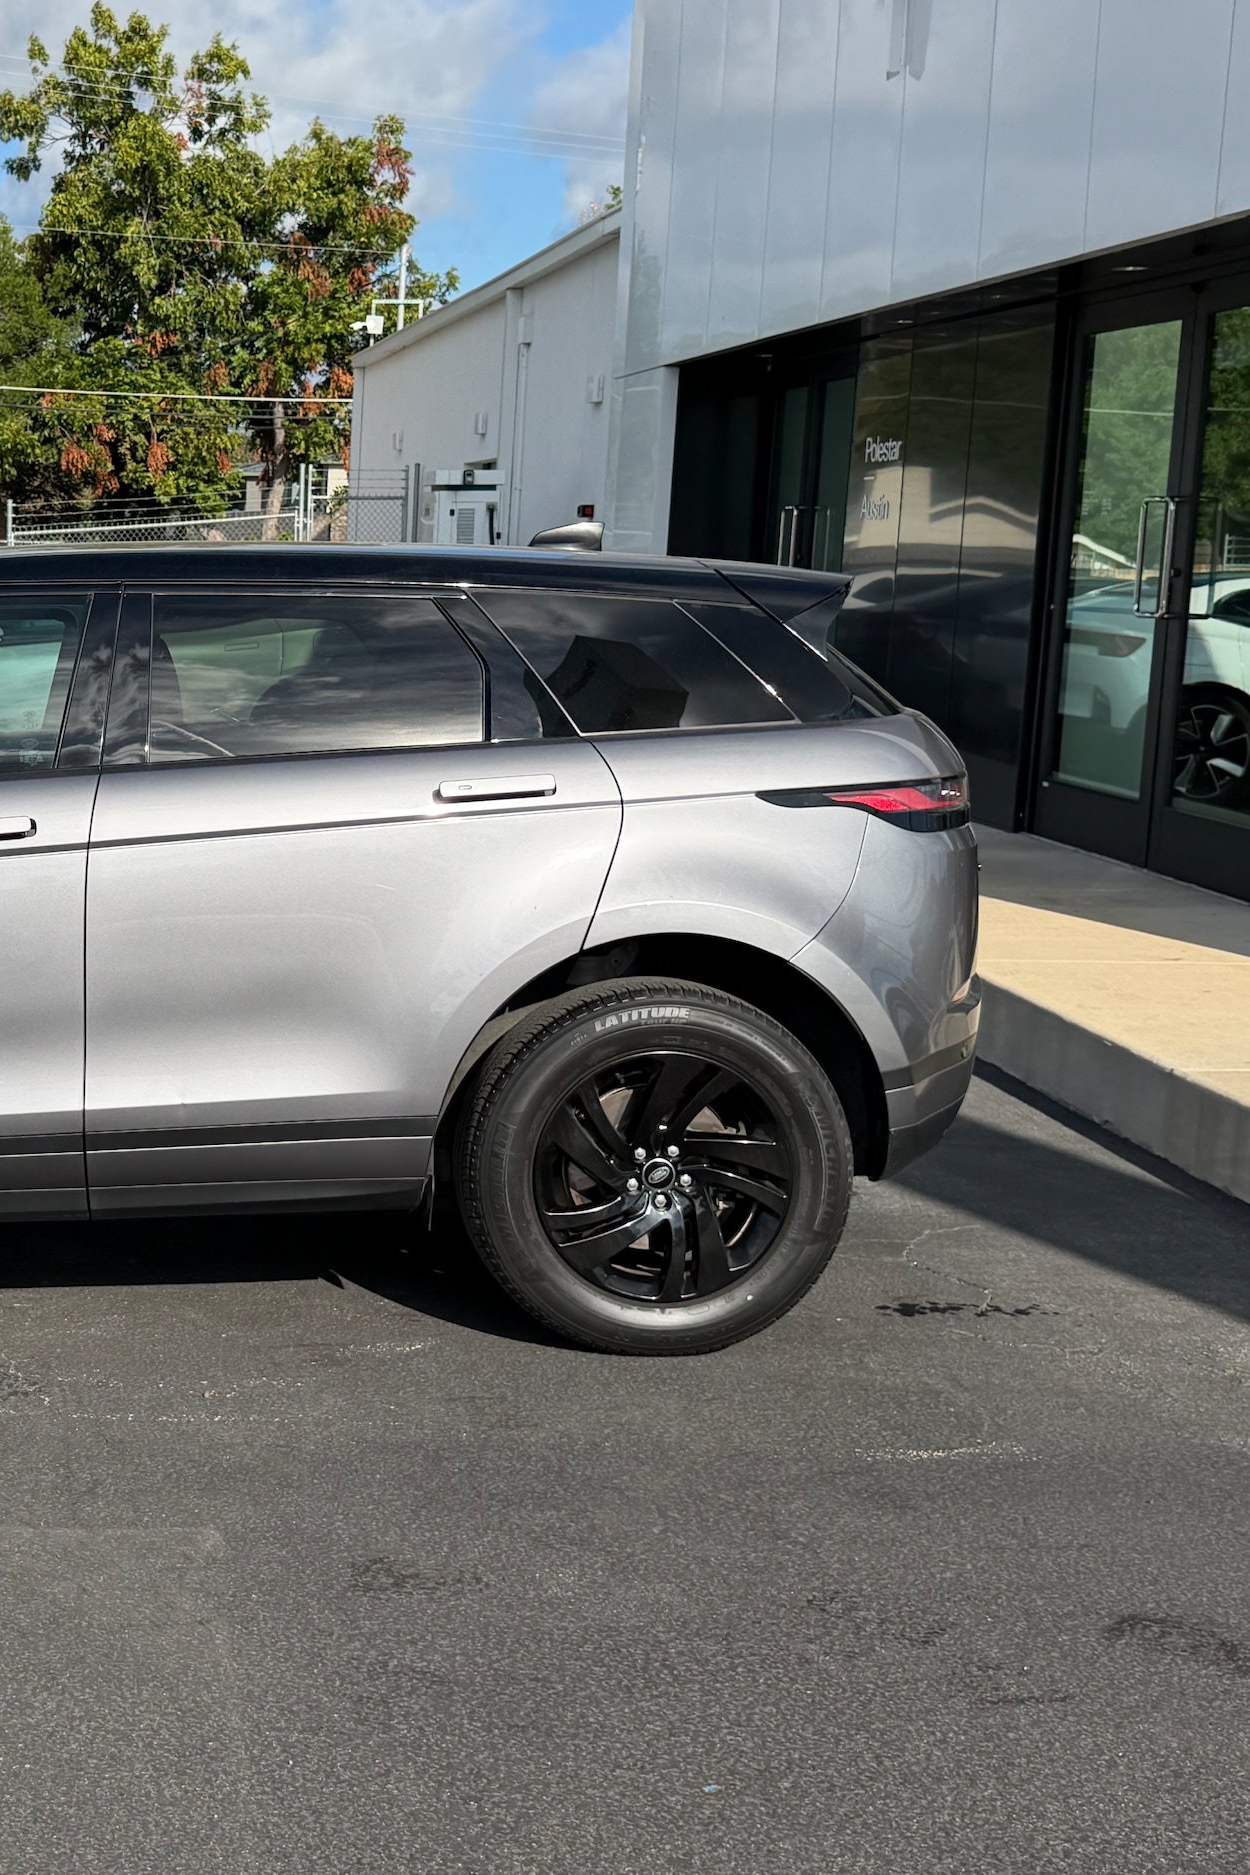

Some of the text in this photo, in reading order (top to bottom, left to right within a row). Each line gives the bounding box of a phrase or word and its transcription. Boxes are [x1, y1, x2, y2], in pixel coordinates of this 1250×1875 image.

[865, 436, 903, 463] Polestar
[860, 494, 890, 520] Austin
[594, 1007, 690, 1032] LATITUDE
